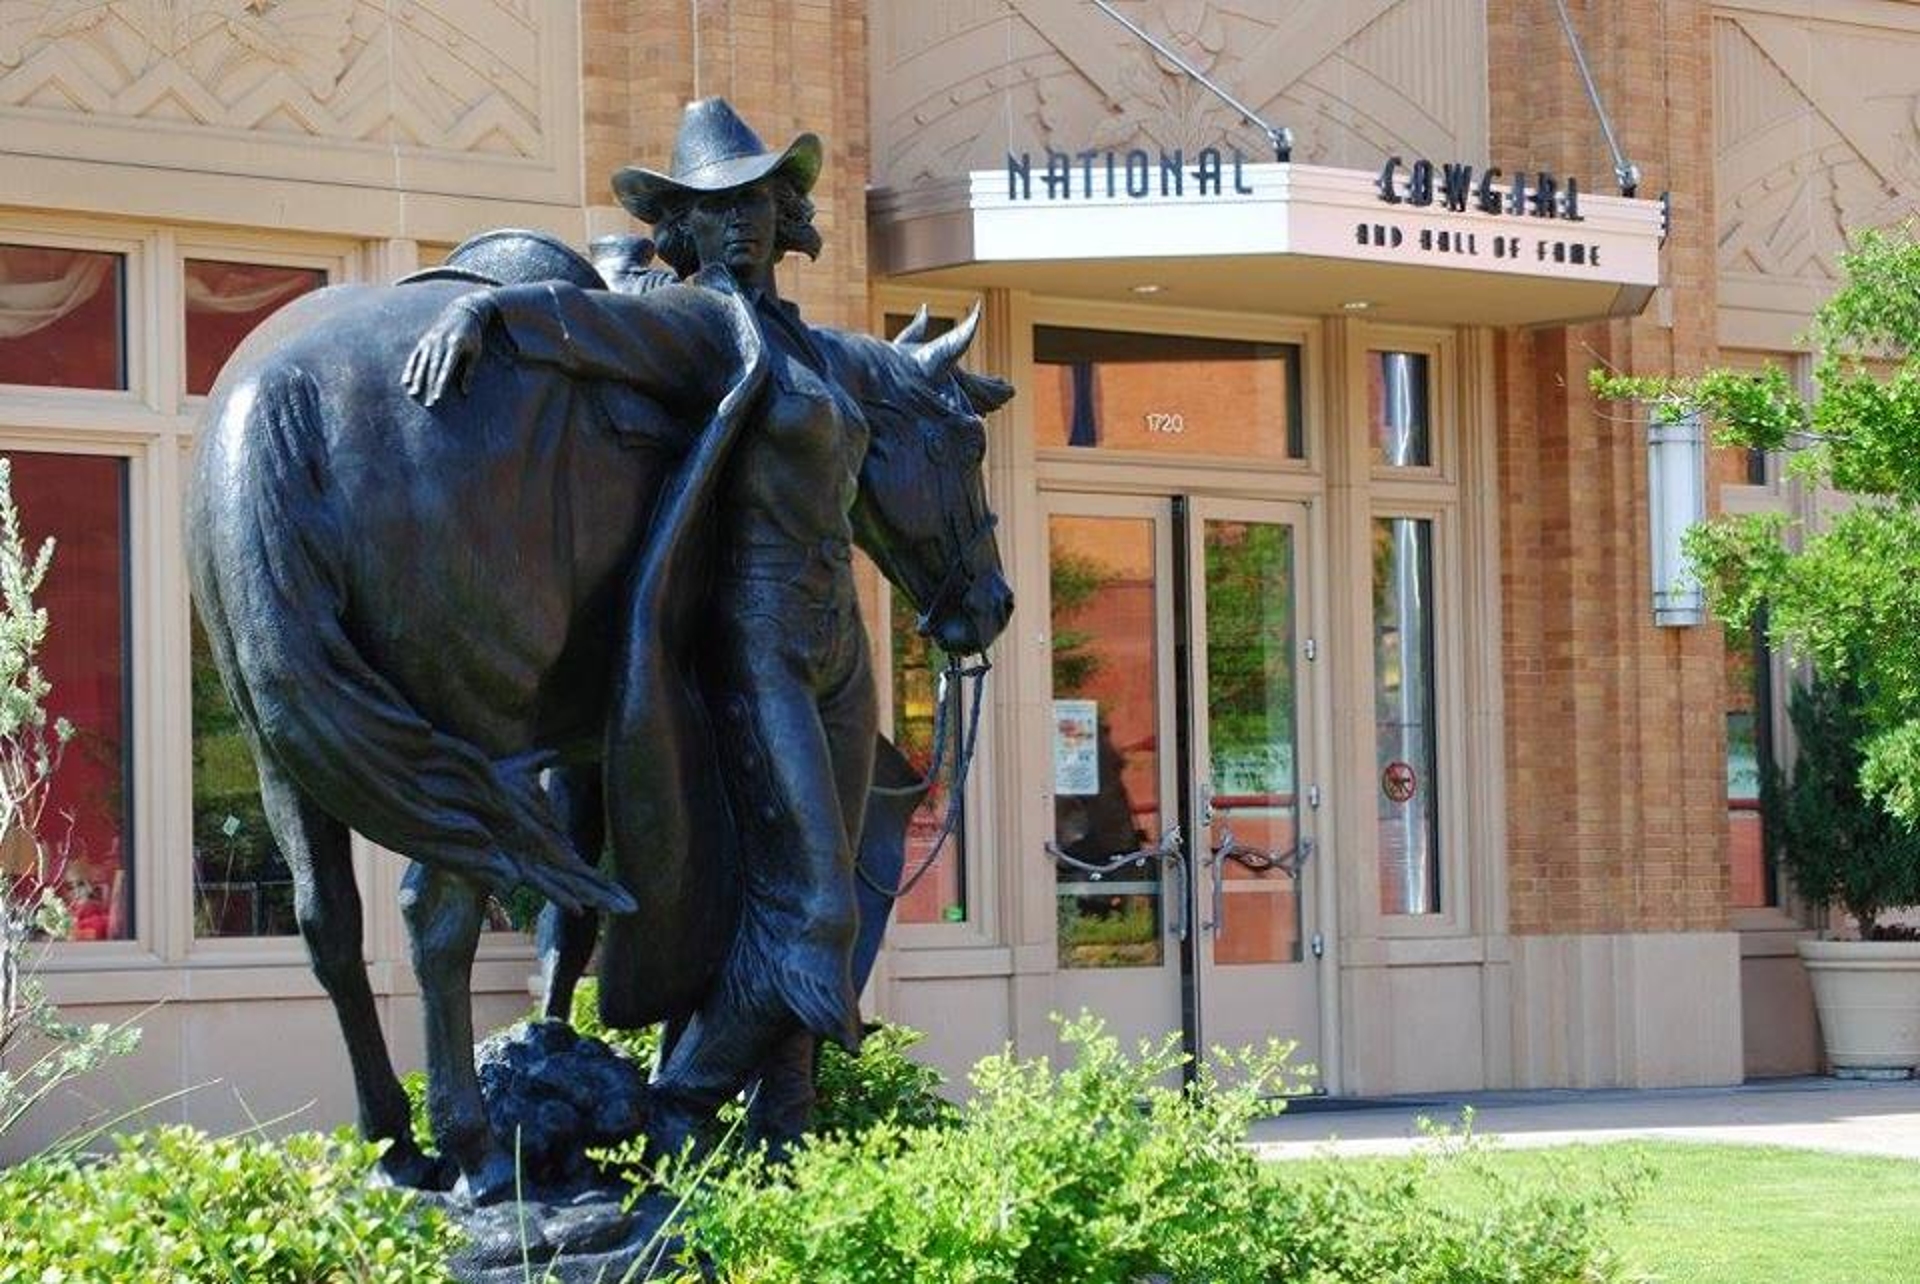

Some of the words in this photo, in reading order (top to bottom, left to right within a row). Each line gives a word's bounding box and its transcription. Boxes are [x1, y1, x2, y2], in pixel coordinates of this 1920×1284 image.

[1008, 148, 1253, 200] NATIONAL
[1375, 156, 1584, 221] COWGIRL
[1356, 224, 1402, 248] AND
[1420, 229, 1477, 255] HALL
[1494, 236, 1520, 258] OF
[1537, 240, 1600, 266] FAME
[1145, 413, 1183, 432] 1720
